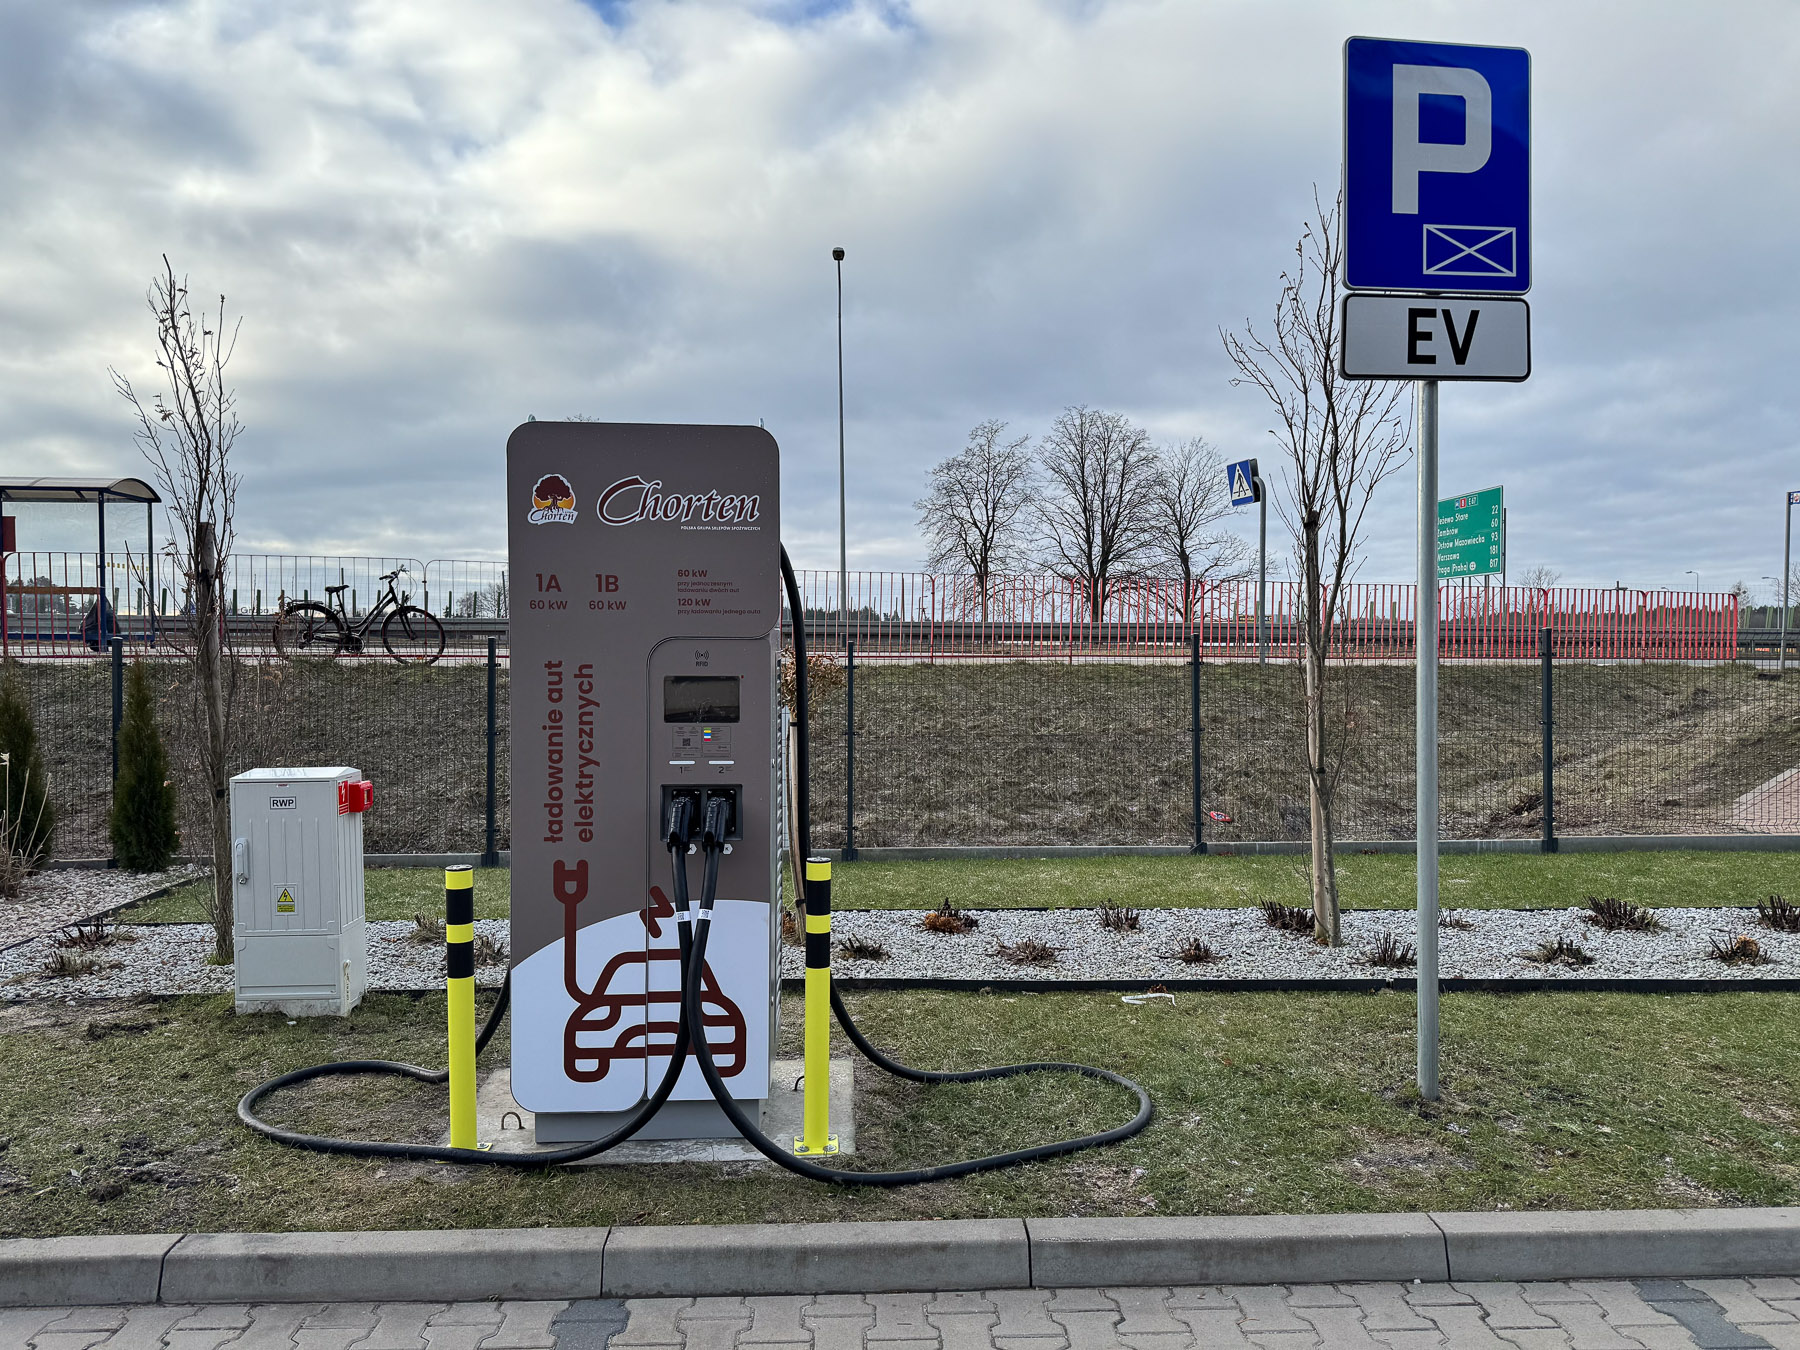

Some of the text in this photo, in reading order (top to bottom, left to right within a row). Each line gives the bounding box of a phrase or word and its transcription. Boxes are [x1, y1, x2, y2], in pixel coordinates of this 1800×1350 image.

[1392, 64, 1492, 215] P
[1406, 308, 1479, 366] EV
[597, 475, 761, 526] Chorten
[530, 509, 574, 521] Chorten
[1455, 513, 1468, 522] Stare
[1491, 505, 1498, 515] 22
[1491, 519, 1498, 528] 60
[1454, 535, 1485, 547] Mazowiecka
[1491, 532, 1498, 541] 93
[1490, 545, 1498, 555] 181
[1490, 558, 1498, 568] 817
[677, 569, 708, 577] 60 kW
[535, 573, 562, 593] 1A
[595, 573, 619, 593] 1B
[529, 600, 568, 610] 60 kW
[588, 600, 627, 610] 60 kW
[677, 598, 711, 606] 120 kW
[543, 660, 564, 843] ładowanie aut
[574, 663, 600, 844] elektrycznych
[271, 799, 294, 808] RWP
